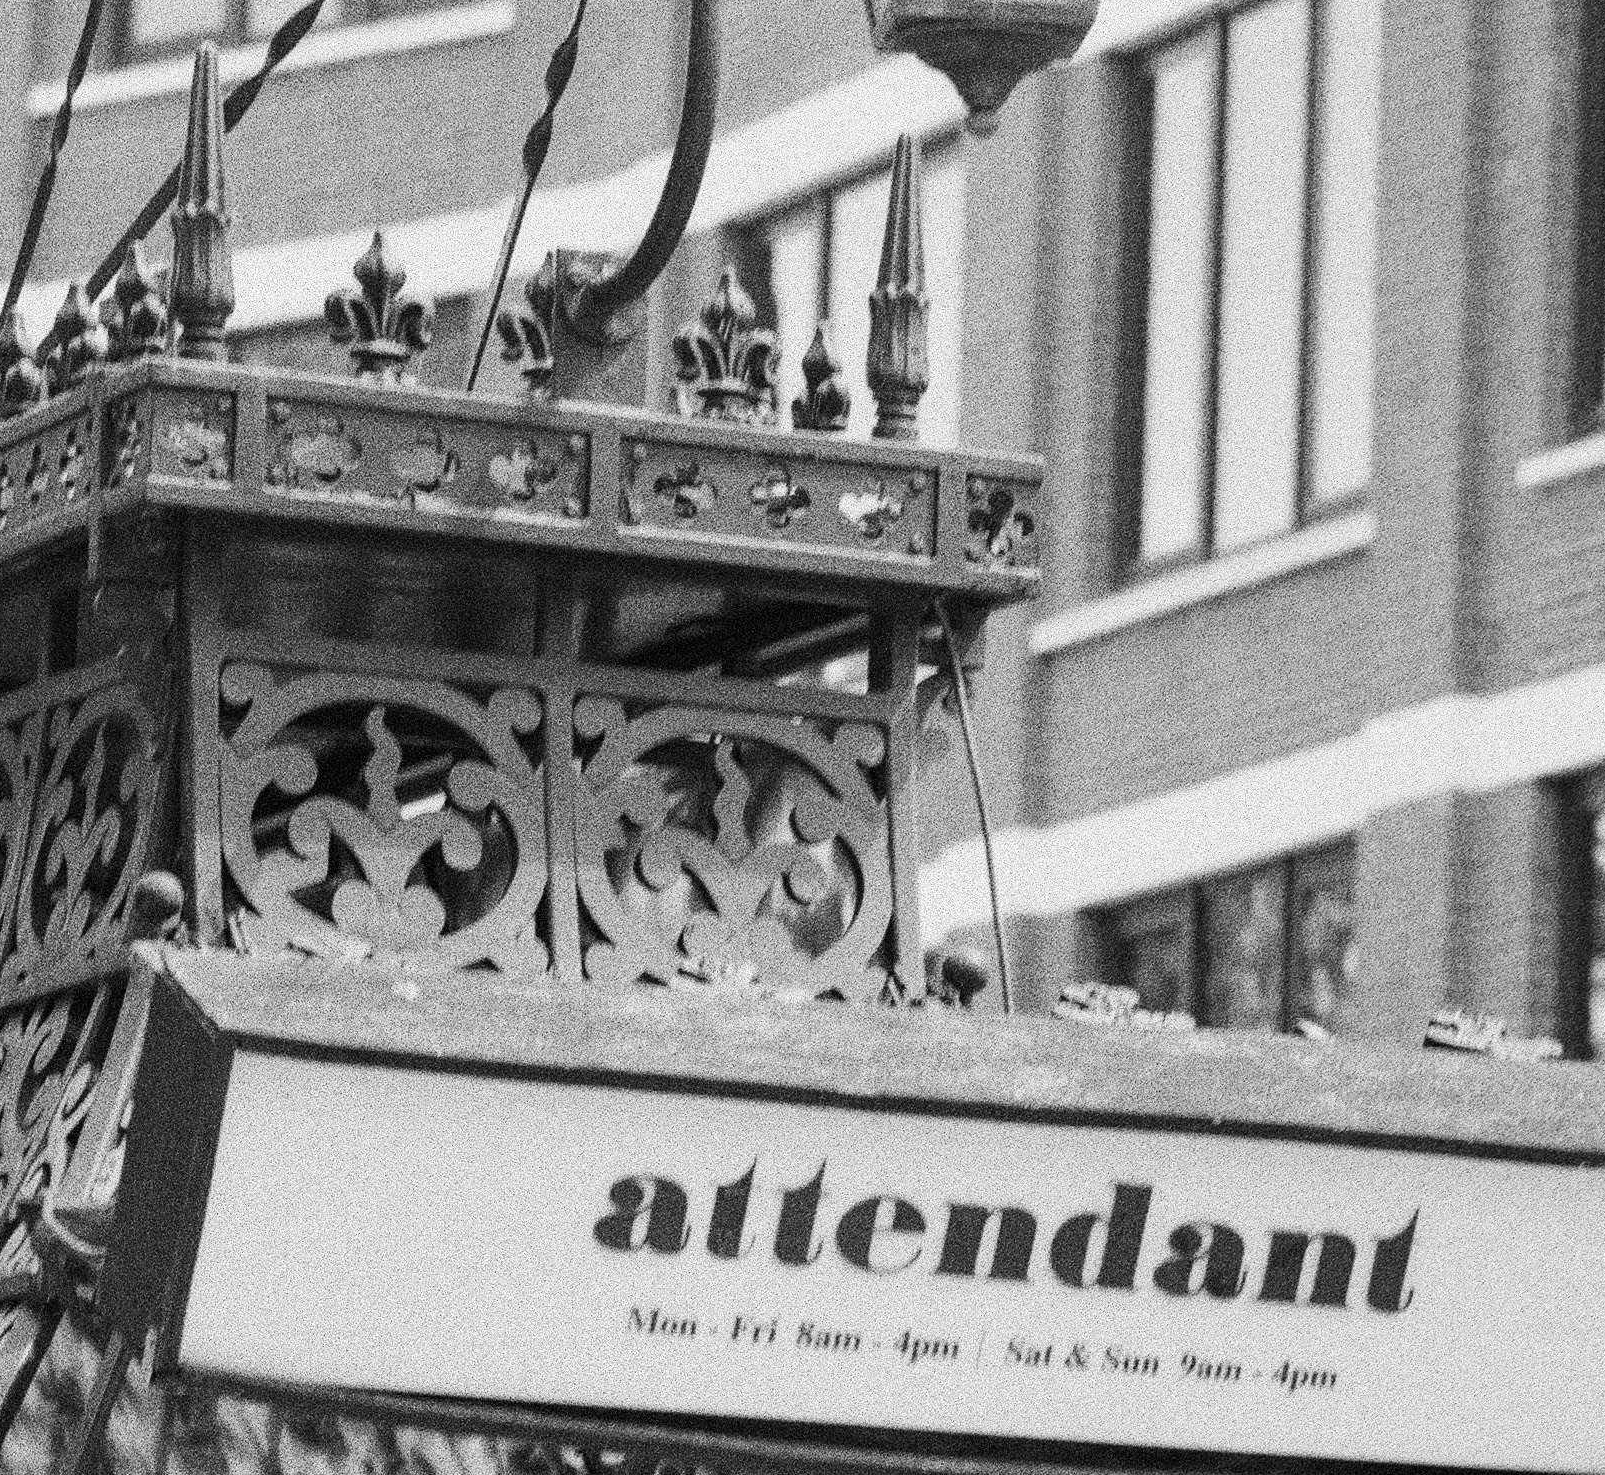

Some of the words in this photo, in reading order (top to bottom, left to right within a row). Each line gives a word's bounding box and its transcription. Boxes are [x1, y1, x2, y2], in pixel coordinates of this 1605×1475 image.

[592, 1153, 1422, 1314] attendant
[626, 1306, 697, 1337] Mon
[730, 1314, 778, 1345] Fri
[795, 1321, 862, 1354] 8am
[895, 1327, 961, 1366] 4pm
[1005, 1337, 1054, 1368] Sat
[1063, 1343, 1090, 1372] &
[1101, 1345, 1161, 1378] Sun
[1180, 1352, 1243, 1383] 9am
[1271, 1358, 1338, 1395] 4pm
